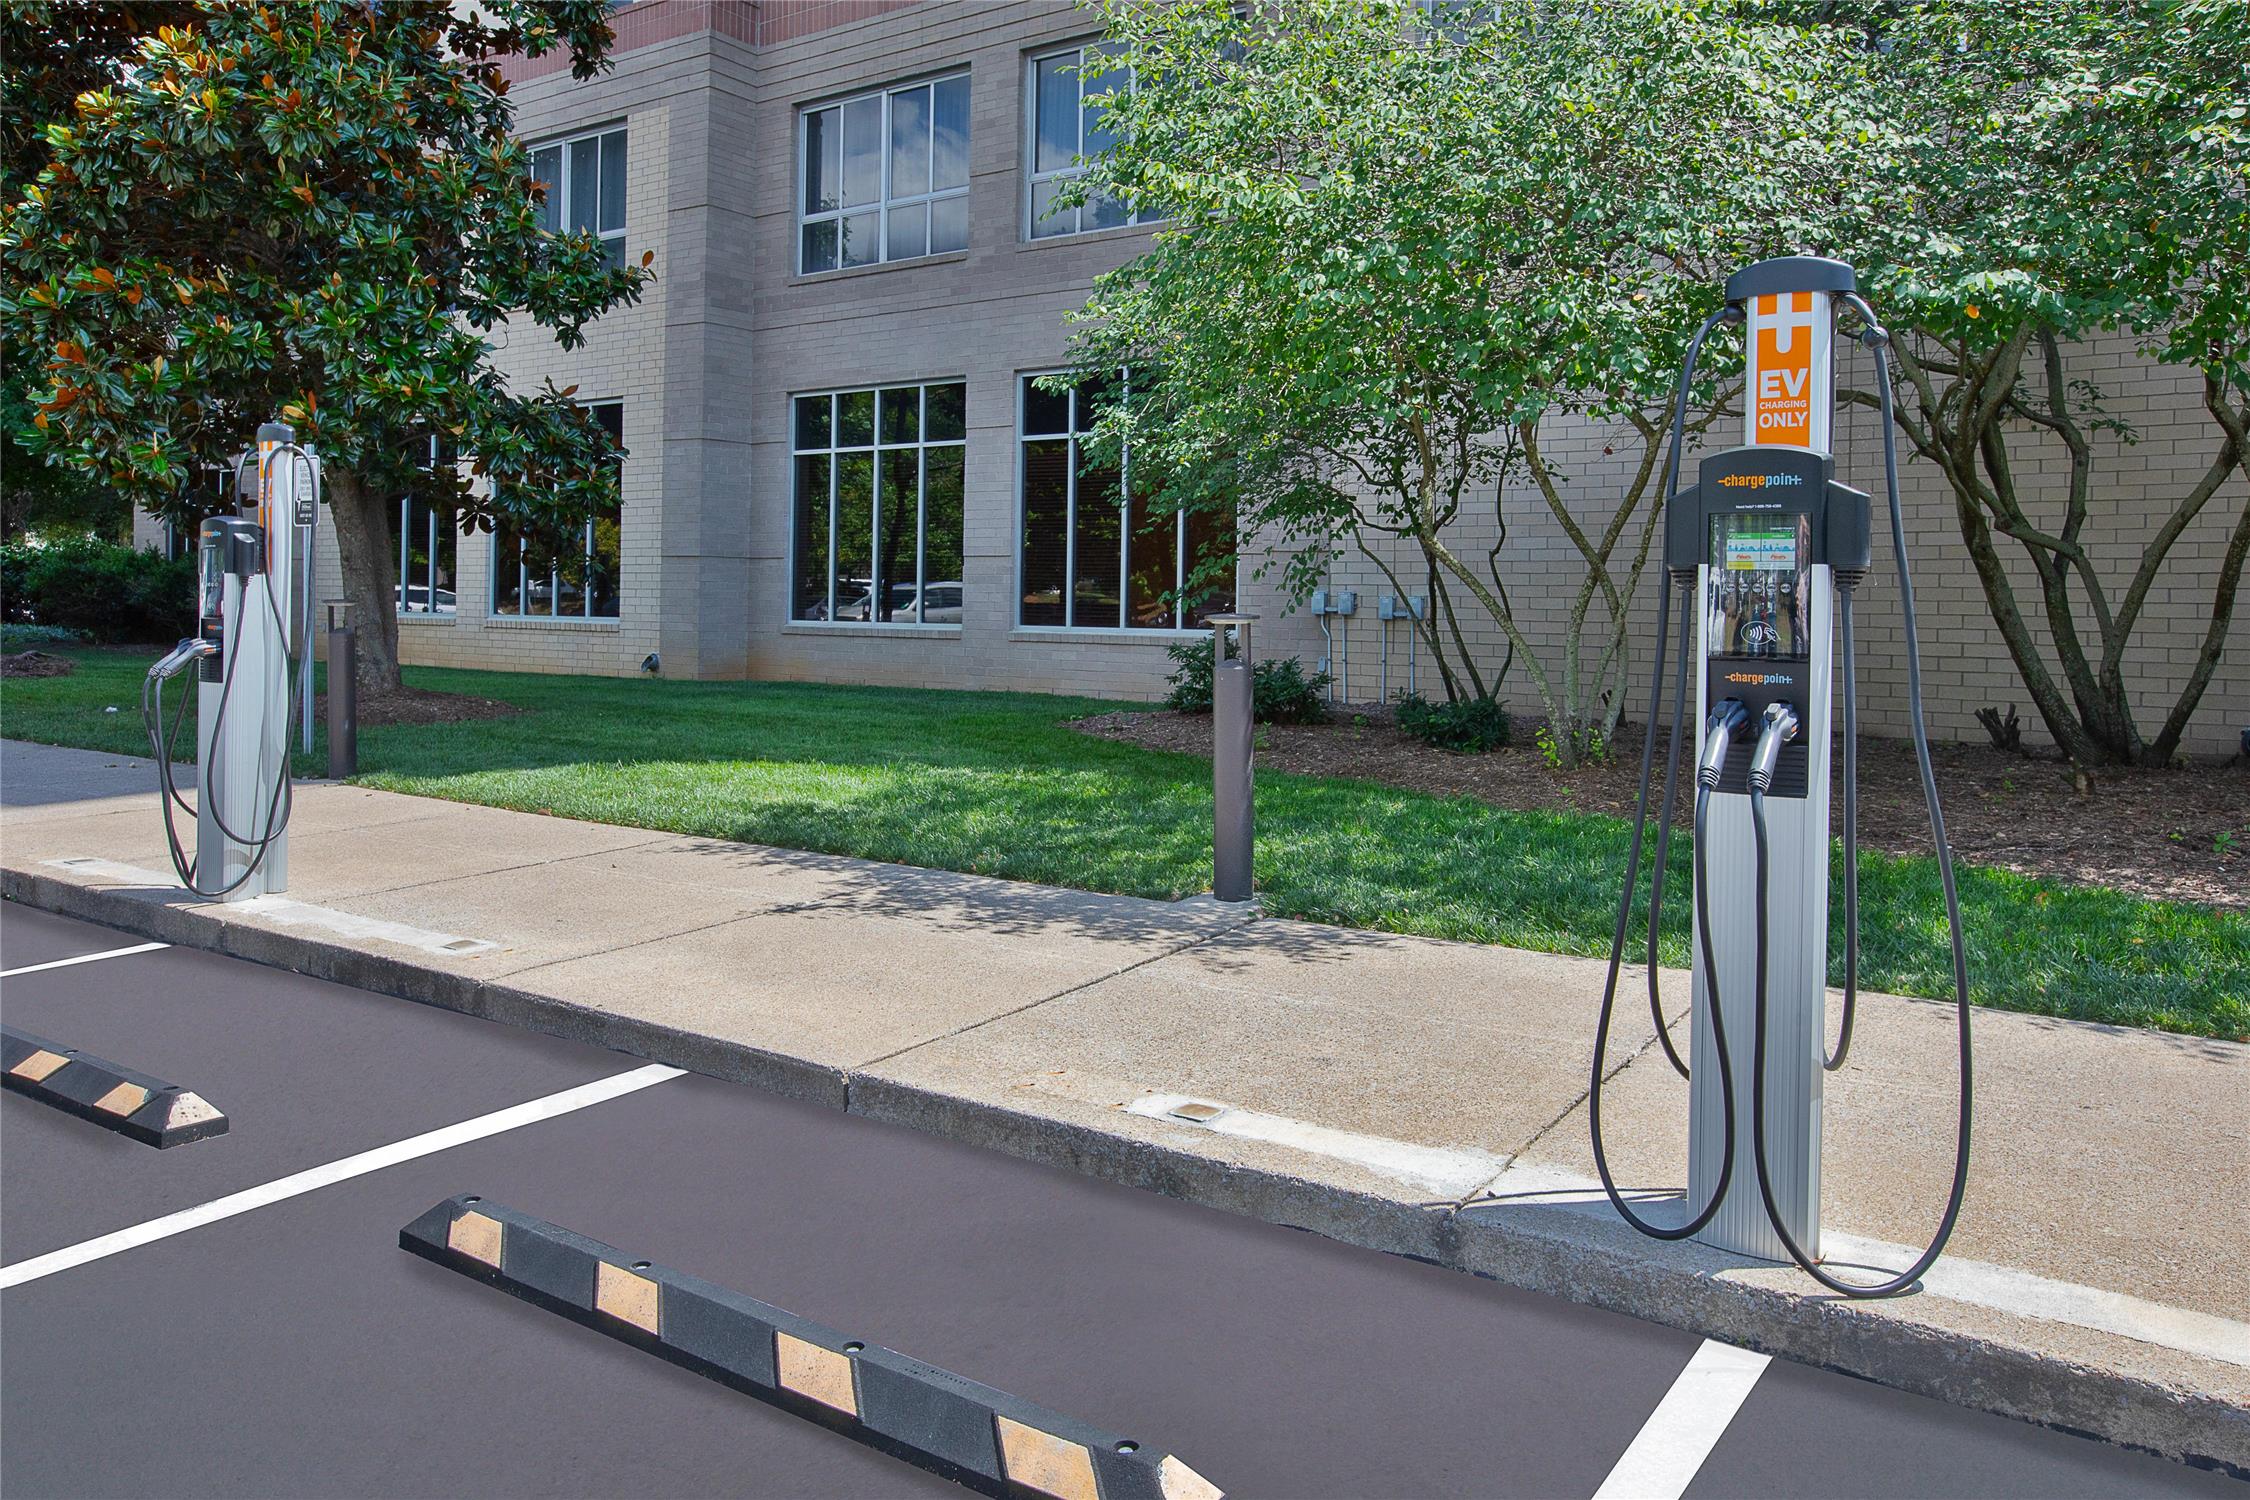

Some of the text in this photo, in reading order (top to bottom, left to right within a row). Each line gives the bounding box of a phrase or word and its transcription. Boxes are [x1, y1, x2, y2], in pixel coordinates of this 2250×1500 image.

[1760, 368, 1808, 398] EV
[1760, 400, 1807, 409] CHARGING
[1760, 412, 1808, 428] ONLY
